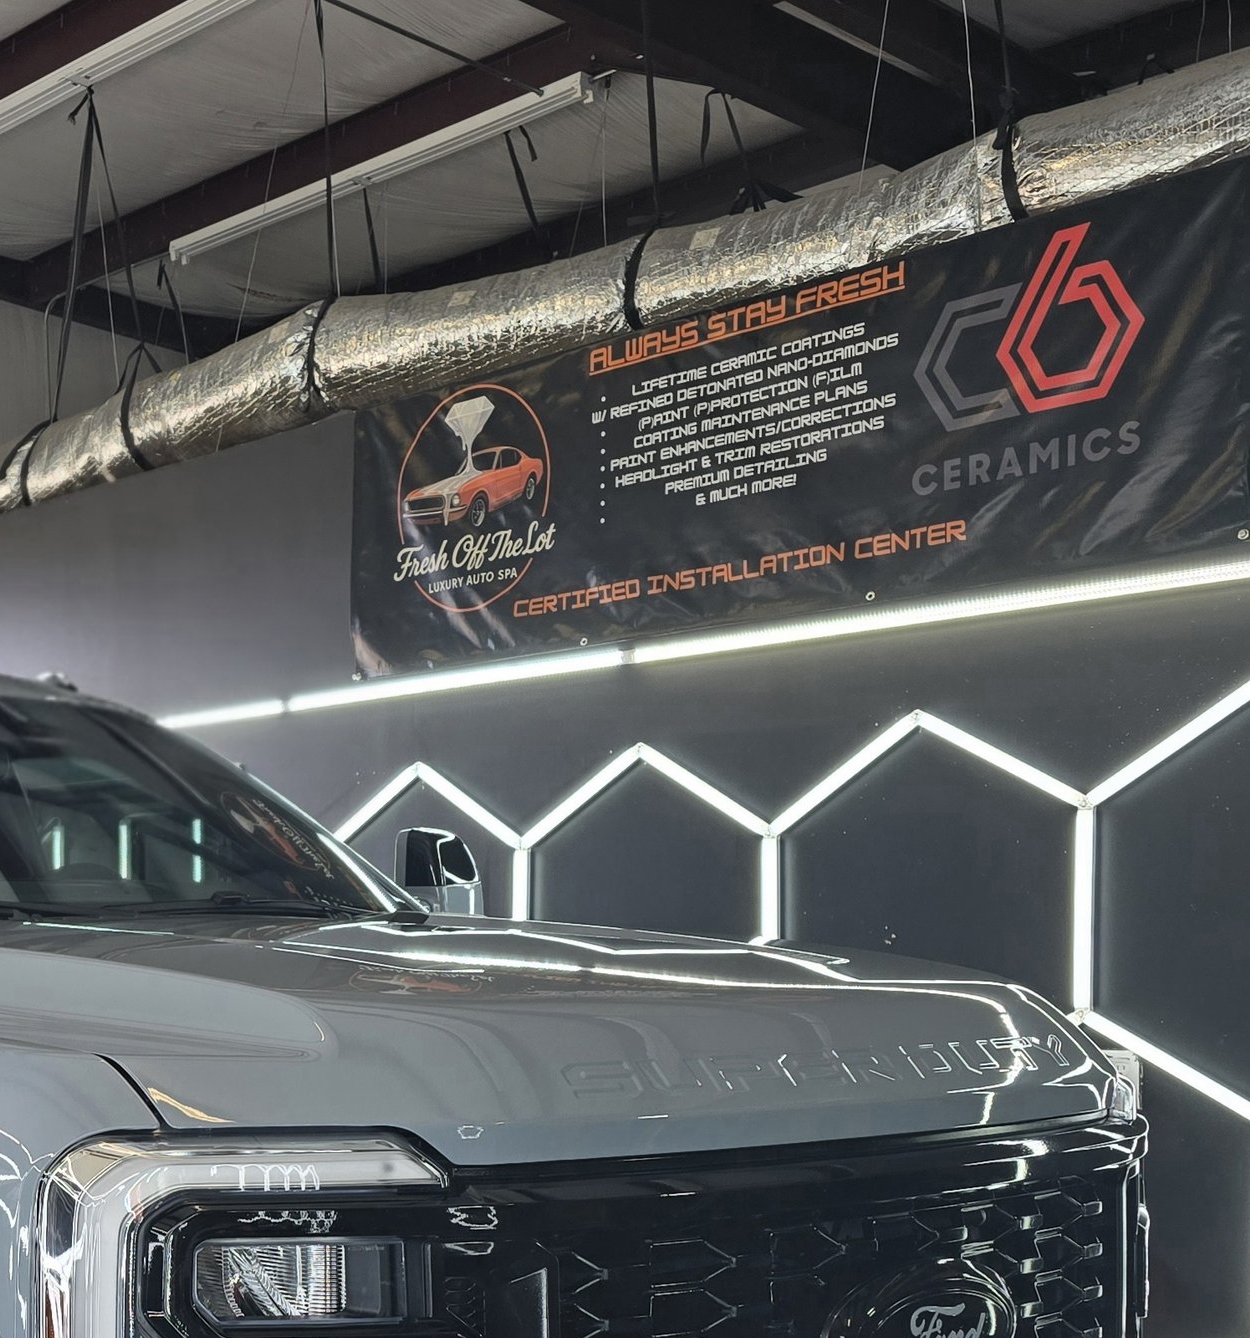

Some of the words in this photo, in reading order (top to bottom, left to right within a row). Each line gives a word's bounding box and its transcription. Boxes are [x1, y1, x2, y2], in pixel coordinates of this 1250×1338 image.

[589, 320, 699, 373] ALWAYS
[707, 295, 786, 339] STAY
[796, 261, 905, 313] FRESH
[592, 409, 607, 424] W/
[610, 392, 673, 419] REFINED
[677, 370, 763, 402] DETONATED
[767, 333, 899, 379] NANO-DIAMONDS
[631, 366, 707, 396] LIFETIME
[711, 346, 777, 376] CERAMIC
[781, 322, 865, 357] COATINGS
[610, 450, 657, 471] PAINT
[660, 393, 896, 460] ENHANCEMENTS/CORRECTIONS
[634, 422, 697, 448] COATING
[701, 395, 810, 432] MAINTENANCE
[814, 380, 868, 405] PLANS
[638, 406, 690, 431] (P)AINT
[693, 376, 808, 417] (P)PROTECTION
[812, 362, 863, 388] (F)ILM
[615, 458, 698, 488] HEADLIGHT
[701, 455, 712, 468] &
[715, 445, 756, 464] TRIM
[760, 415, 885, 456] RESTORATIONS
[665, 469, 730, 495] PREMIUM
[733, 449, 827, 479] DETAILING
[911, 420, 1142, 497] CERAMICS
[695, 493, 706, 506] &
[709, 483, 748, 503] MUCH
[751, 473, 797, 494] MORE!
[393, 540, 449, 582] Fresh
[452, 533, 491, 571] Off
[428, 576, 464, 594] LUXURY
[466, 571, 495, 586] AUTO
[497, 567, 518, 581] SPA
[513, 578, 641, 618] CERTIFIED
[647, 542, 846, 596] INSTALLATION
[853, 519, 967, 560] CENTER
